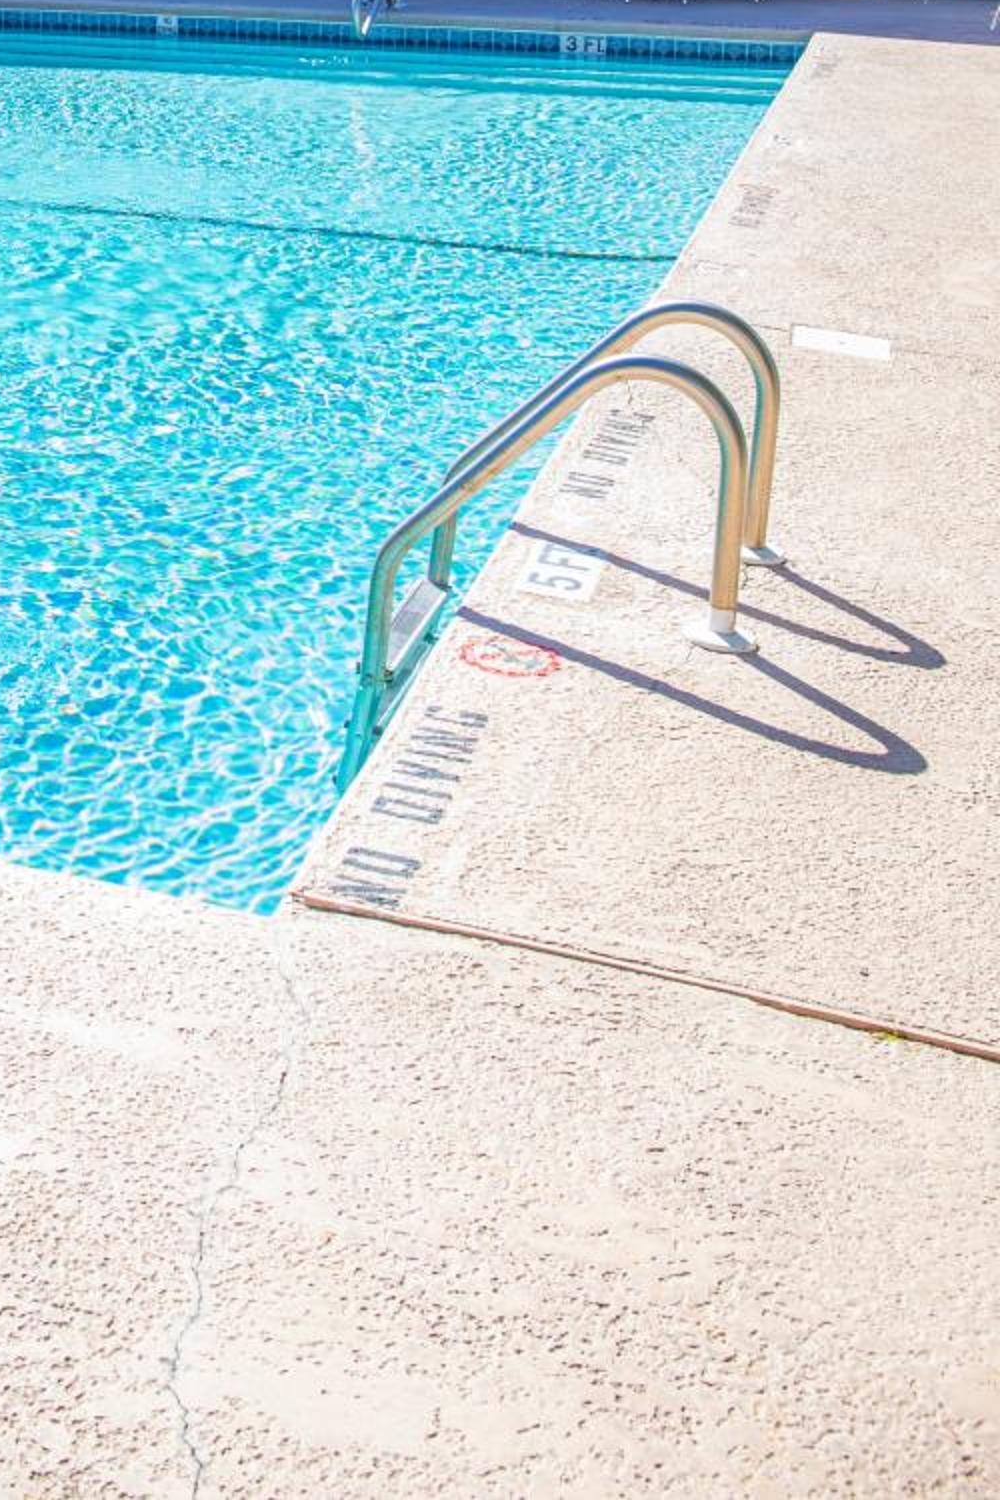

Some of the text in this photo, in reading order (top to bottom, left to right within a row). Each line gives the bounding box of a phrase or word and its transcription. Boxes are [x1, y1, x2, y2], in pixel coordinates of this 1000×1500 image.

[566, 35, 578, 52] 3
[559, 408, 656, 499] NO DIVING
[528, 571, 583, 591] 5
[328, 705, 489, 908] NO DIVING
